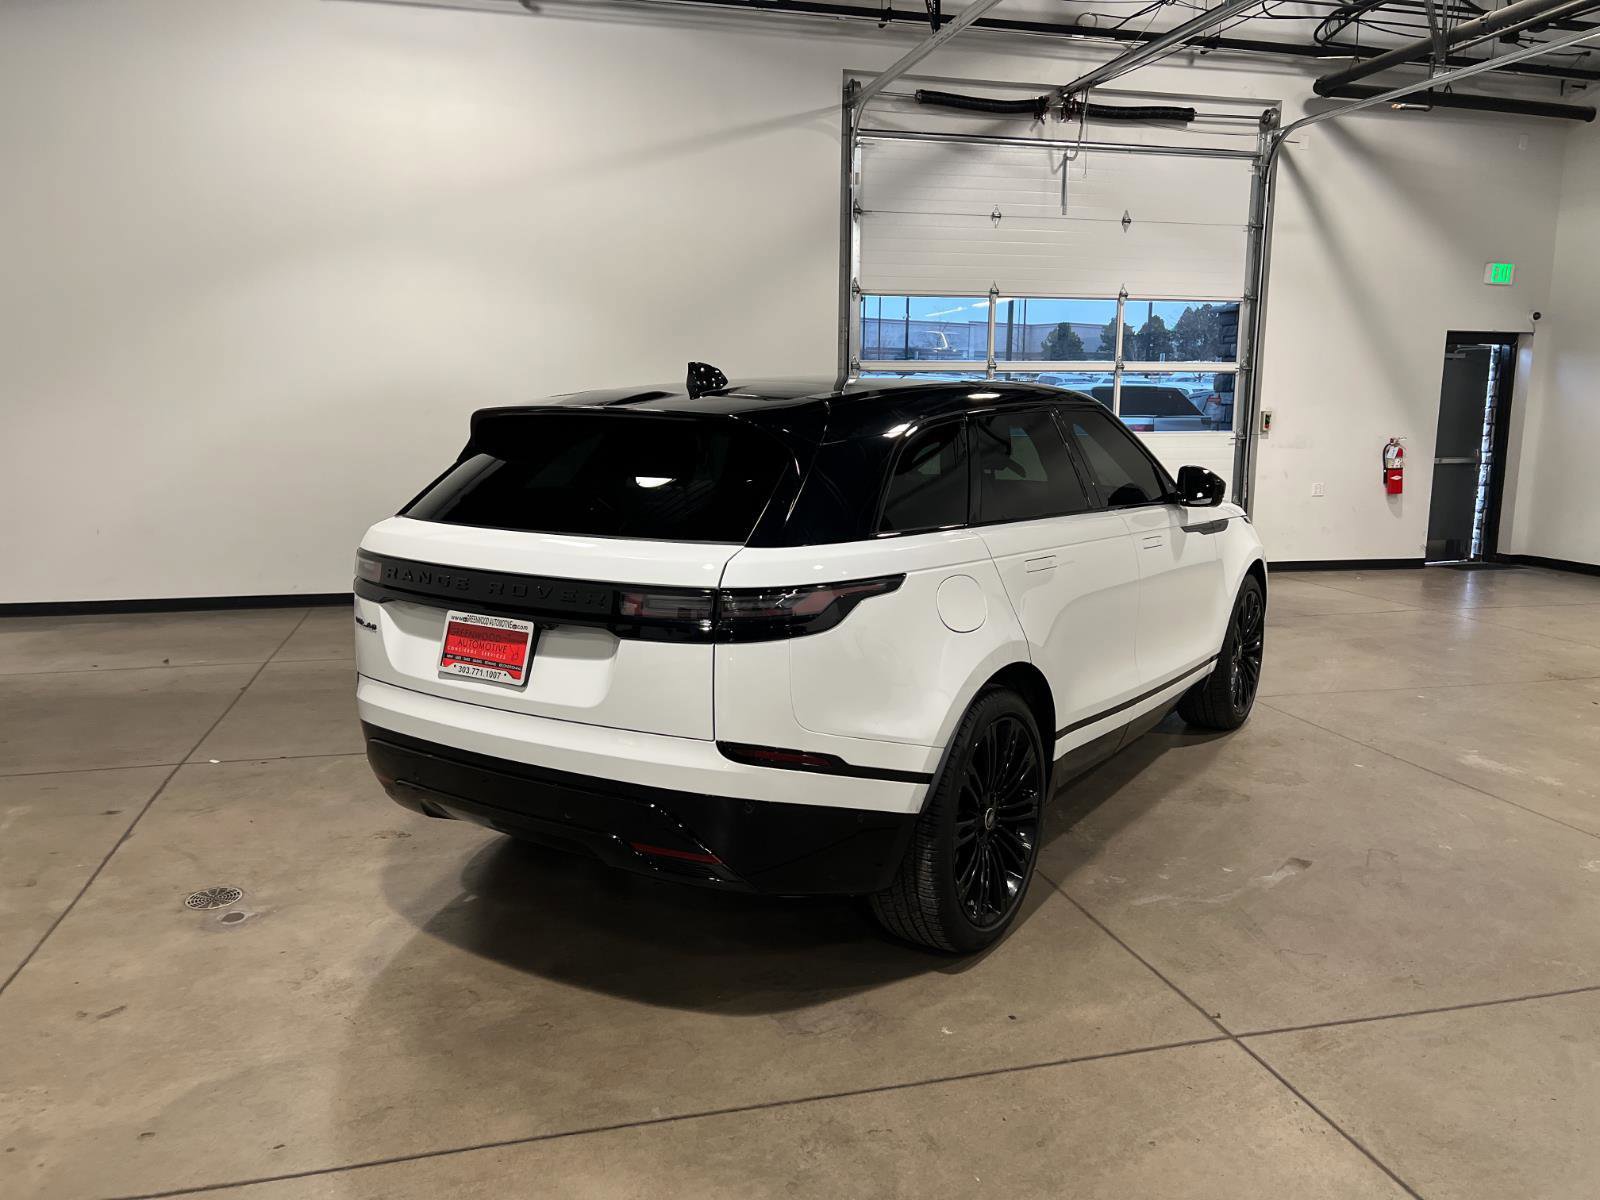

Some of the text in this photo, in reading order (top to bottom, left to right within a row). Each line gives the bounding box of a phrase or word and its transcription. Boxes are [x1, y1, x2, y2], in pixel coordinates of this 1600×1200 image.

[1492, 263, 1512, 283] EXIT
[385, 566, 608, 609] RANGE ROVER
[457, 638, 508, 653] AUTOMOTIVE
